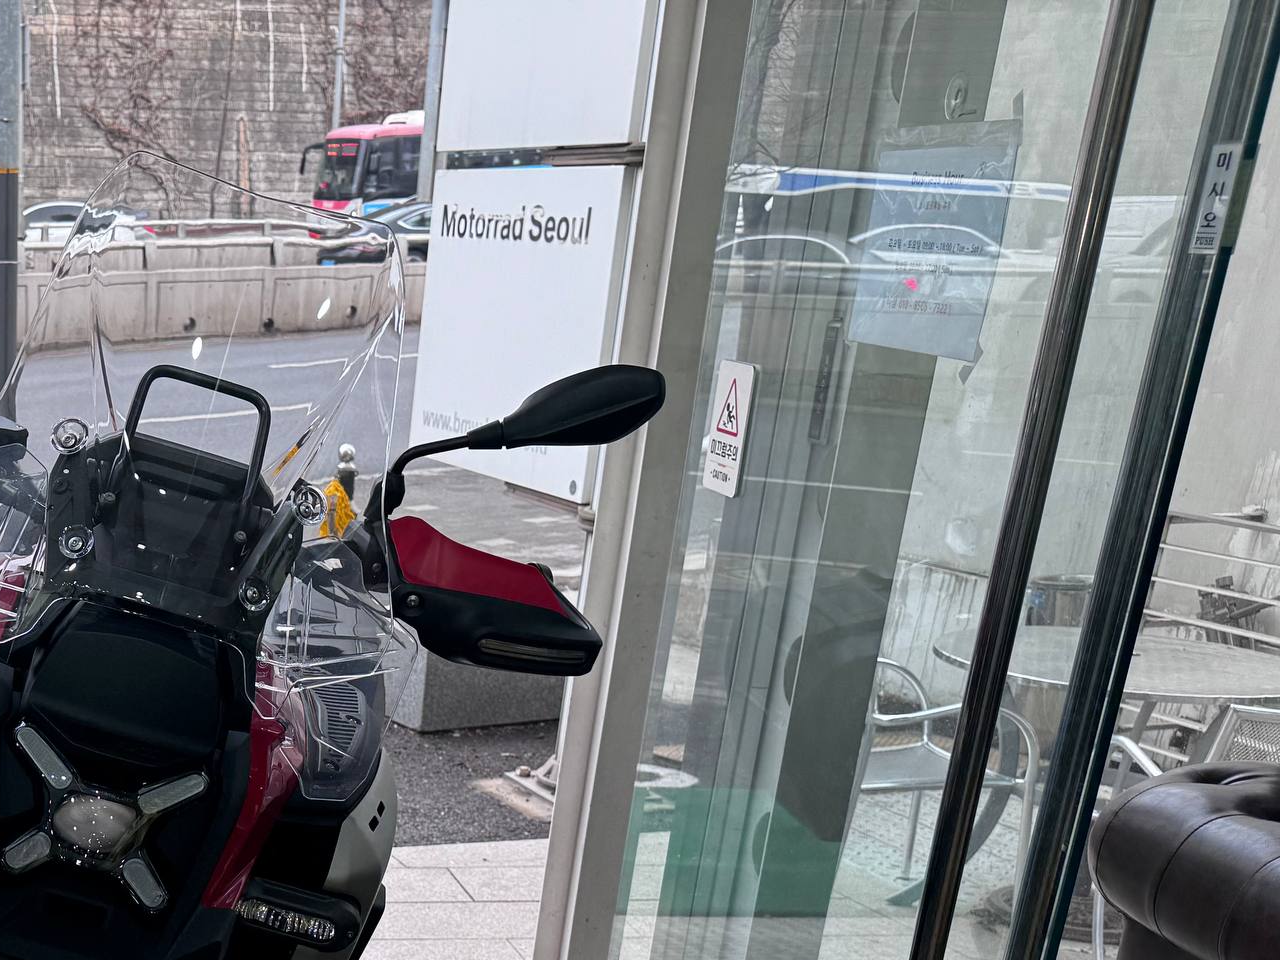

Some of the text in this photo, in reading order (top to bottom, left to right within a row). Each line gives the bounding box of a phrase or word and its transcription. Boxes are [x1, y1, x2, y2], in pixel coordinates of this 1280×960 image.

[1200, 150, 1232, 228] 미시오
[441, 204, 592, 245] Motorrad Seoul
[1194, 236, 1214, 246] PUSH
[710, 438, 738, 462] 미끄럼주의
